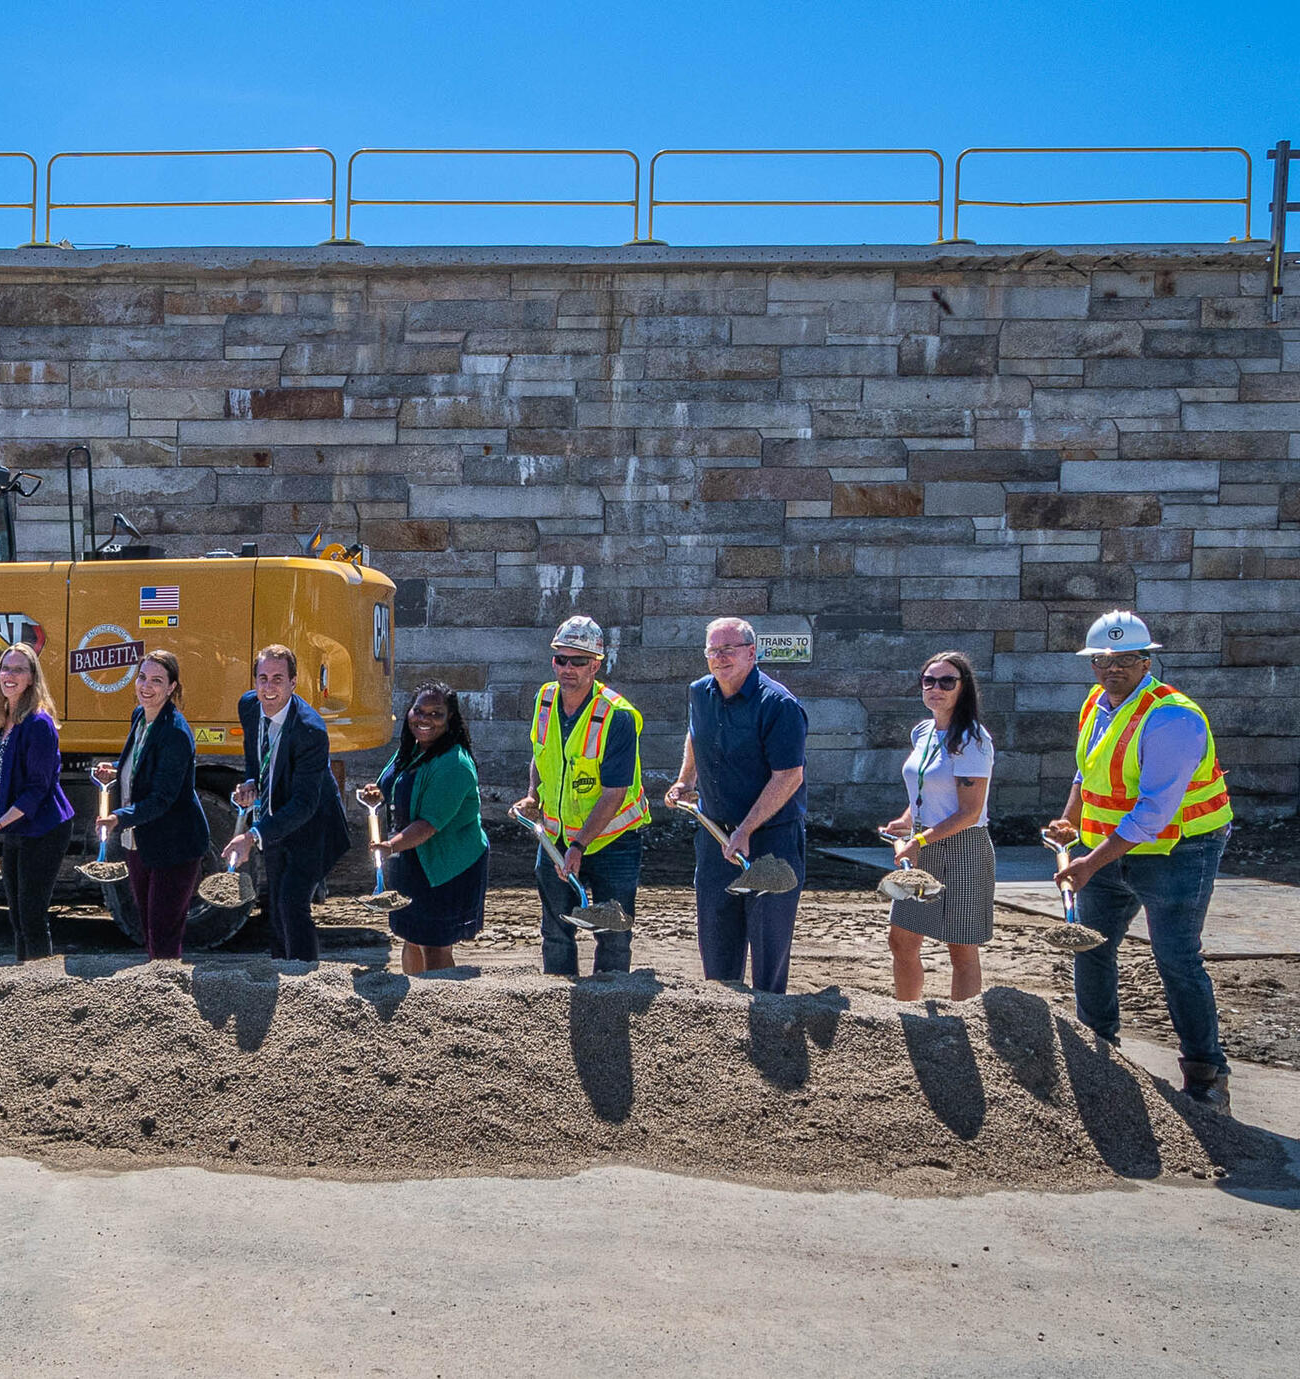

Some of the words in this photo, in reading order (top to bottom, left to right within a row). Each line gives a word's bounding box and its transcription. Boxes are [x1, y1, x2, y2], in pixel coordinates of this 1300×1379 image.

[760, 637, 793, 646] TRAINS
[796, 637, 809, 646] TO
[75, 645, 139, 671] BARLETTA
